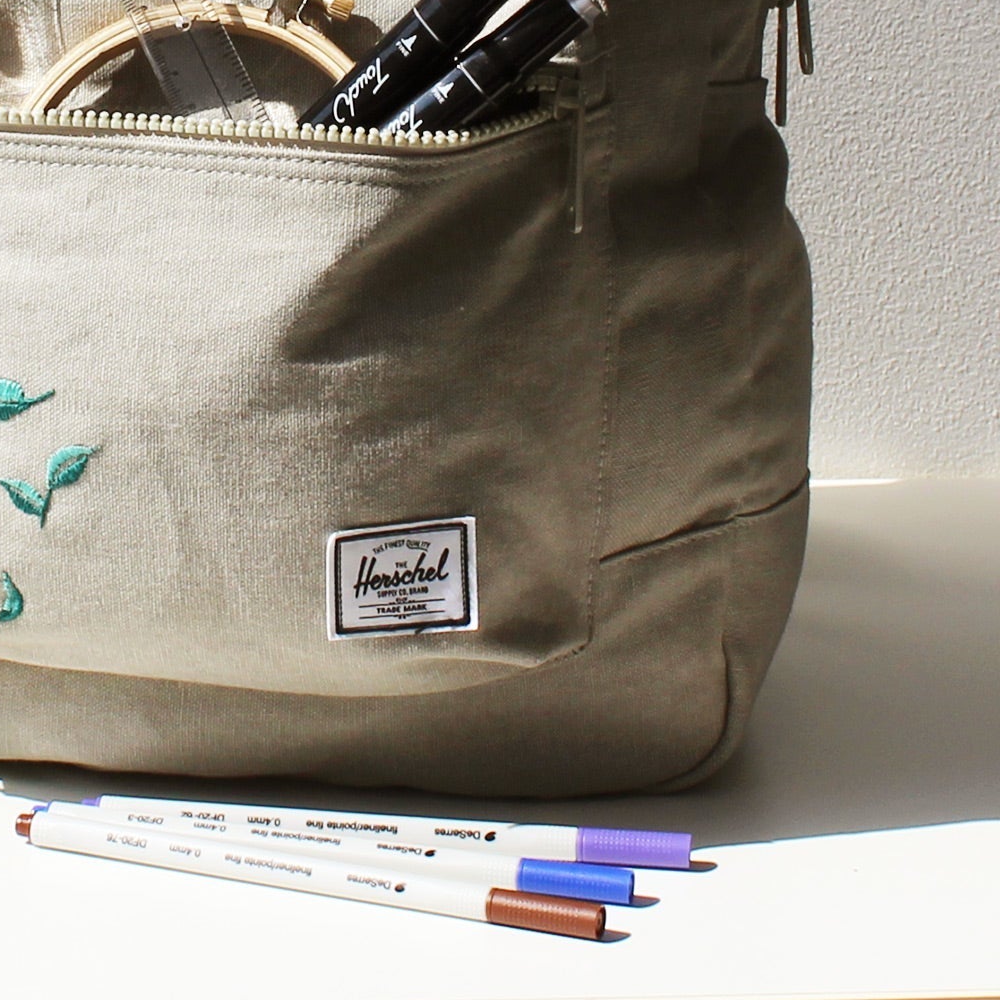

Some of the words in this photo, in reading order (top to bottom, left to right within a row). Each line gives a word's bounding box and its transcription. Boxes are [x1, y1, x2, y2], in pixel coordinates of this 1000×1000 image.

[333, 57, 390, 123] Touch
[385, 539, 405, 550] FINEST
[353, 547, 449, 599] Herschel
[377, 589, 398, 598] SUPPLY
[409, 586, 429, 595] BRAND
[377, 605, 401, 614] TRADE
[403, 603, 427, 612] MARK
[193, 822, 227, 832] 0.4mm
[247, 816, 281, 827] 0.4mm
[306, 820, 324, 829] fine
[326, 821, 398, 834] fineliner/pointe
[251, 828, 268, 837] fine
[434, 828, 481, 840] DeSerres
[169, 843, 201, 858] 0.4mm
[225, 853, 241, 865] fine
[245, 855, 312, 876] fineliner/pointe
[346, 874, 391, 890] DeSerres
